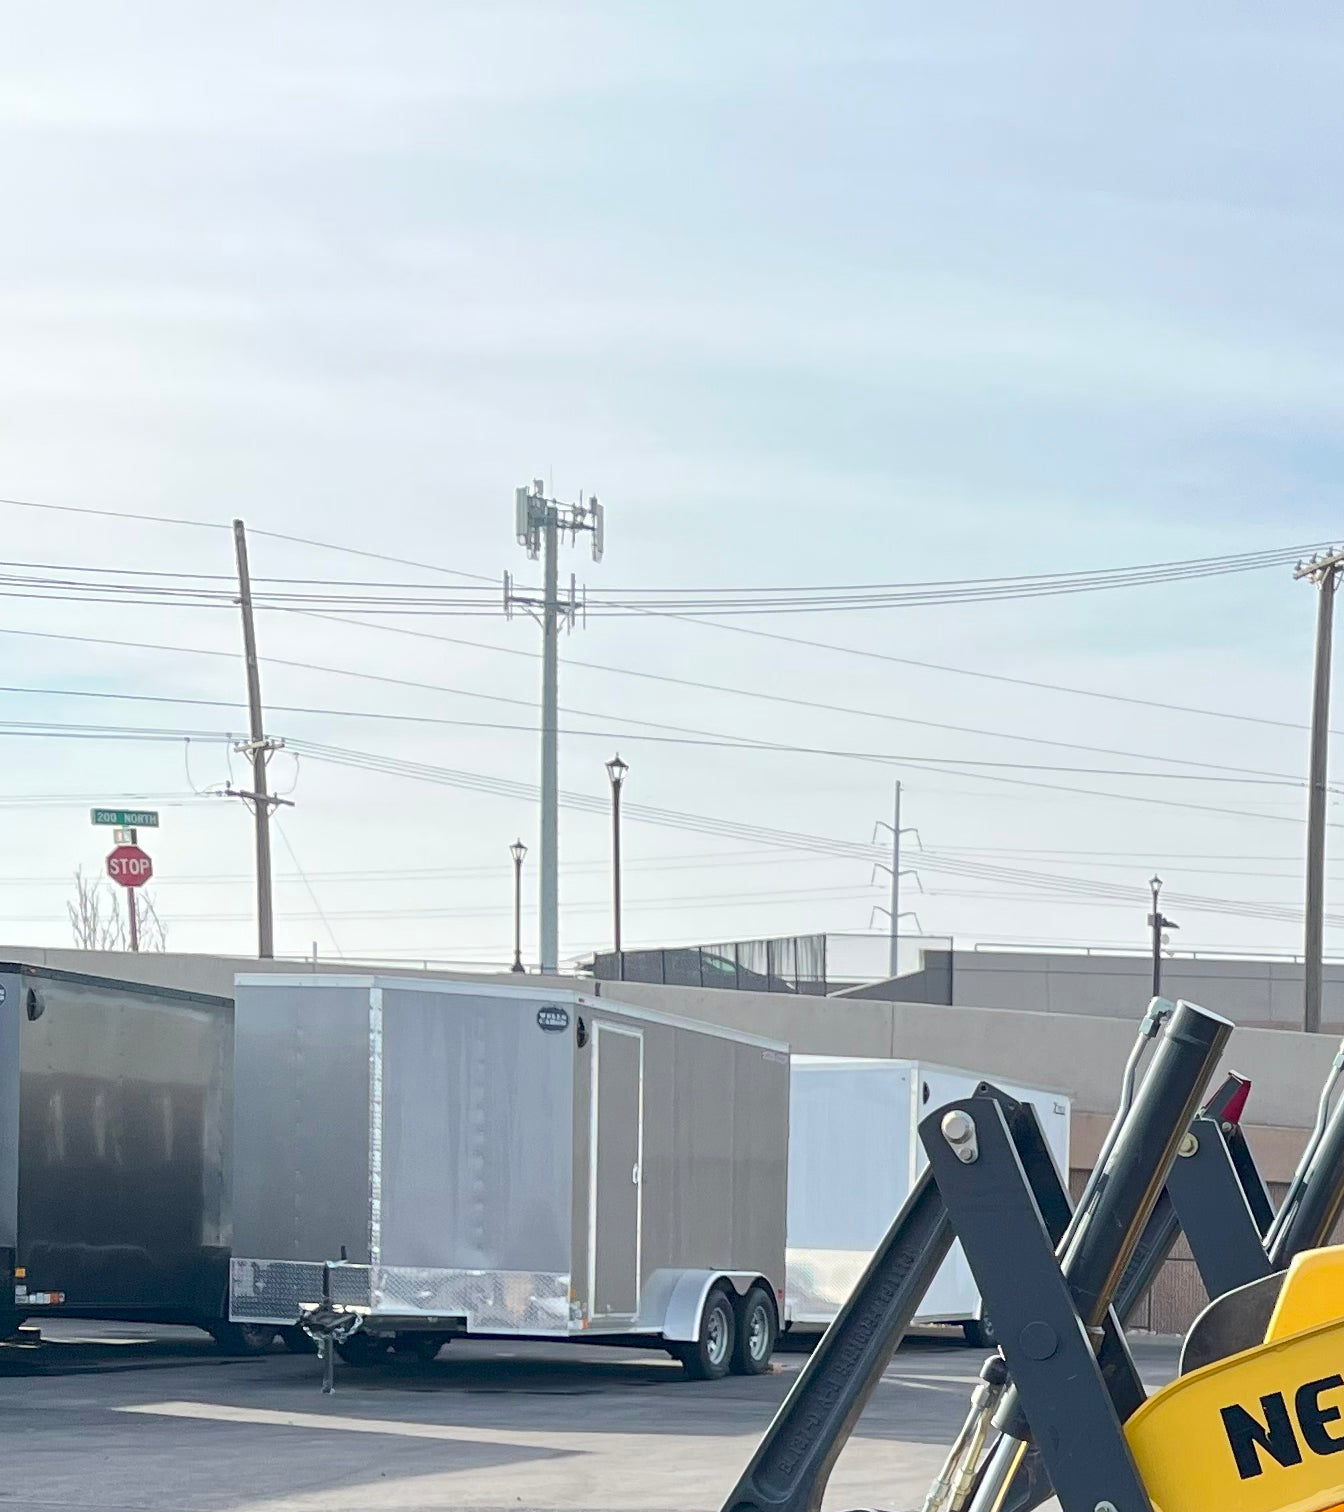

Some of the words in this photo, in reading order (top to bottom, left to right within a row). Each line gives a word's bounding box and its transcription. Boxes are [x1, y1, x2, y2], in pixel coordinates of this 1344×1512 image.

[97, 811, 117, 823] 200
[123, 813, 156, 824] NORTH
[109, 858, 150, 875] STOP
